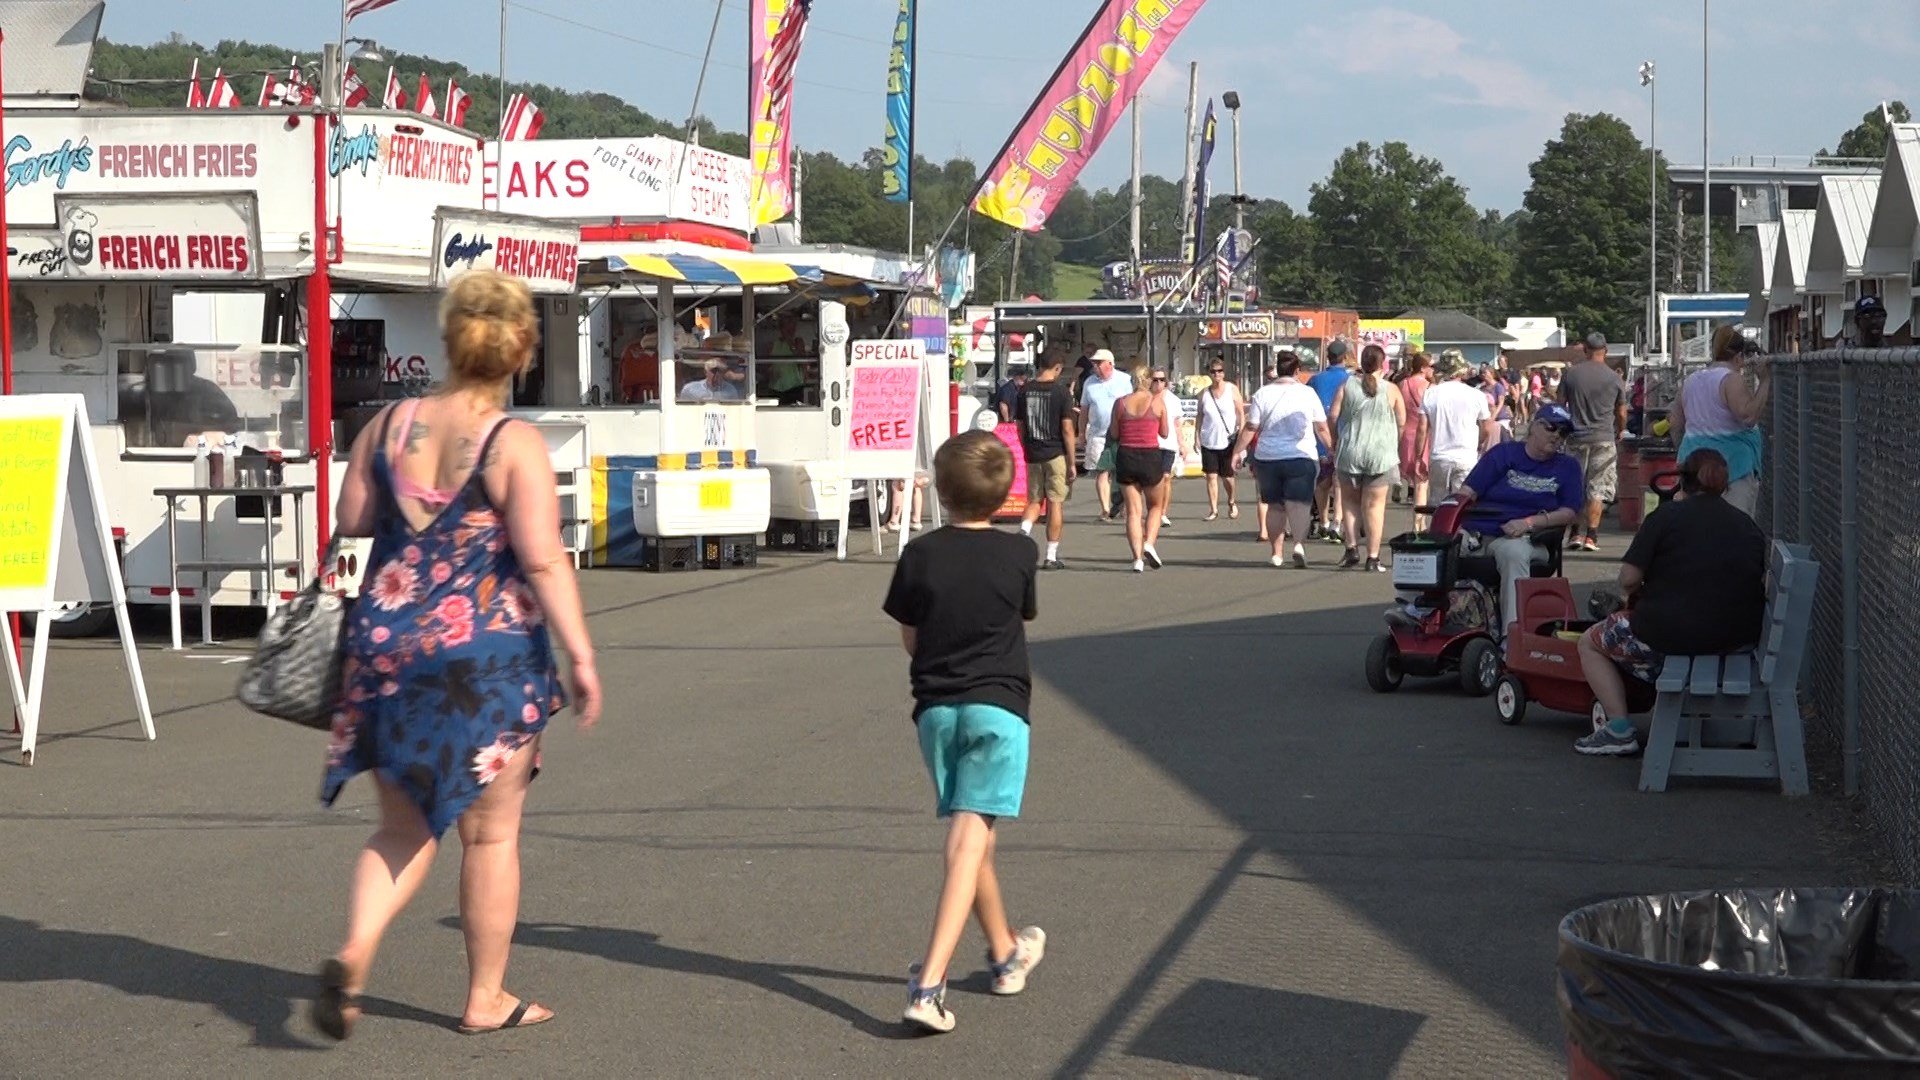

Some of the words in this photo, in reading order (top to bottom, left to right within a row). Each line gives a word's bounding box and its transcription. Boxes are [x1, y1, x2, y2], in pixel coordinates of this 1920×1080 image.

[1023, 0, 1186, 180] EMONADE
[99, 145, 188, 178] FRENCH
[193, 144, 258, 178] FRIES
[388, 133, 439, 180] FRENCH
[438, 142, 473, 186] FRIES
[593, 145, 629, 172] FOOT
[628, 166, 663, 192] LONG
[625, 143, 663, 171] GIANT
[689, 149, 729, 184] CHEESE
[691, 185, 730, 220] STEAKS
[18, 247, 63, 265] FRESH
[40, 256, 68, 276] CUT
[98, 235, 182, 270] FRENCH
[186, 235, 249, 273] FRIES
[495, 236, 545, 279] FRENCH
[543, 241, 579, 284] FRIES
[854, 343, 919, 360] SPECIAL
[851, 420, 911, 446] FREE
